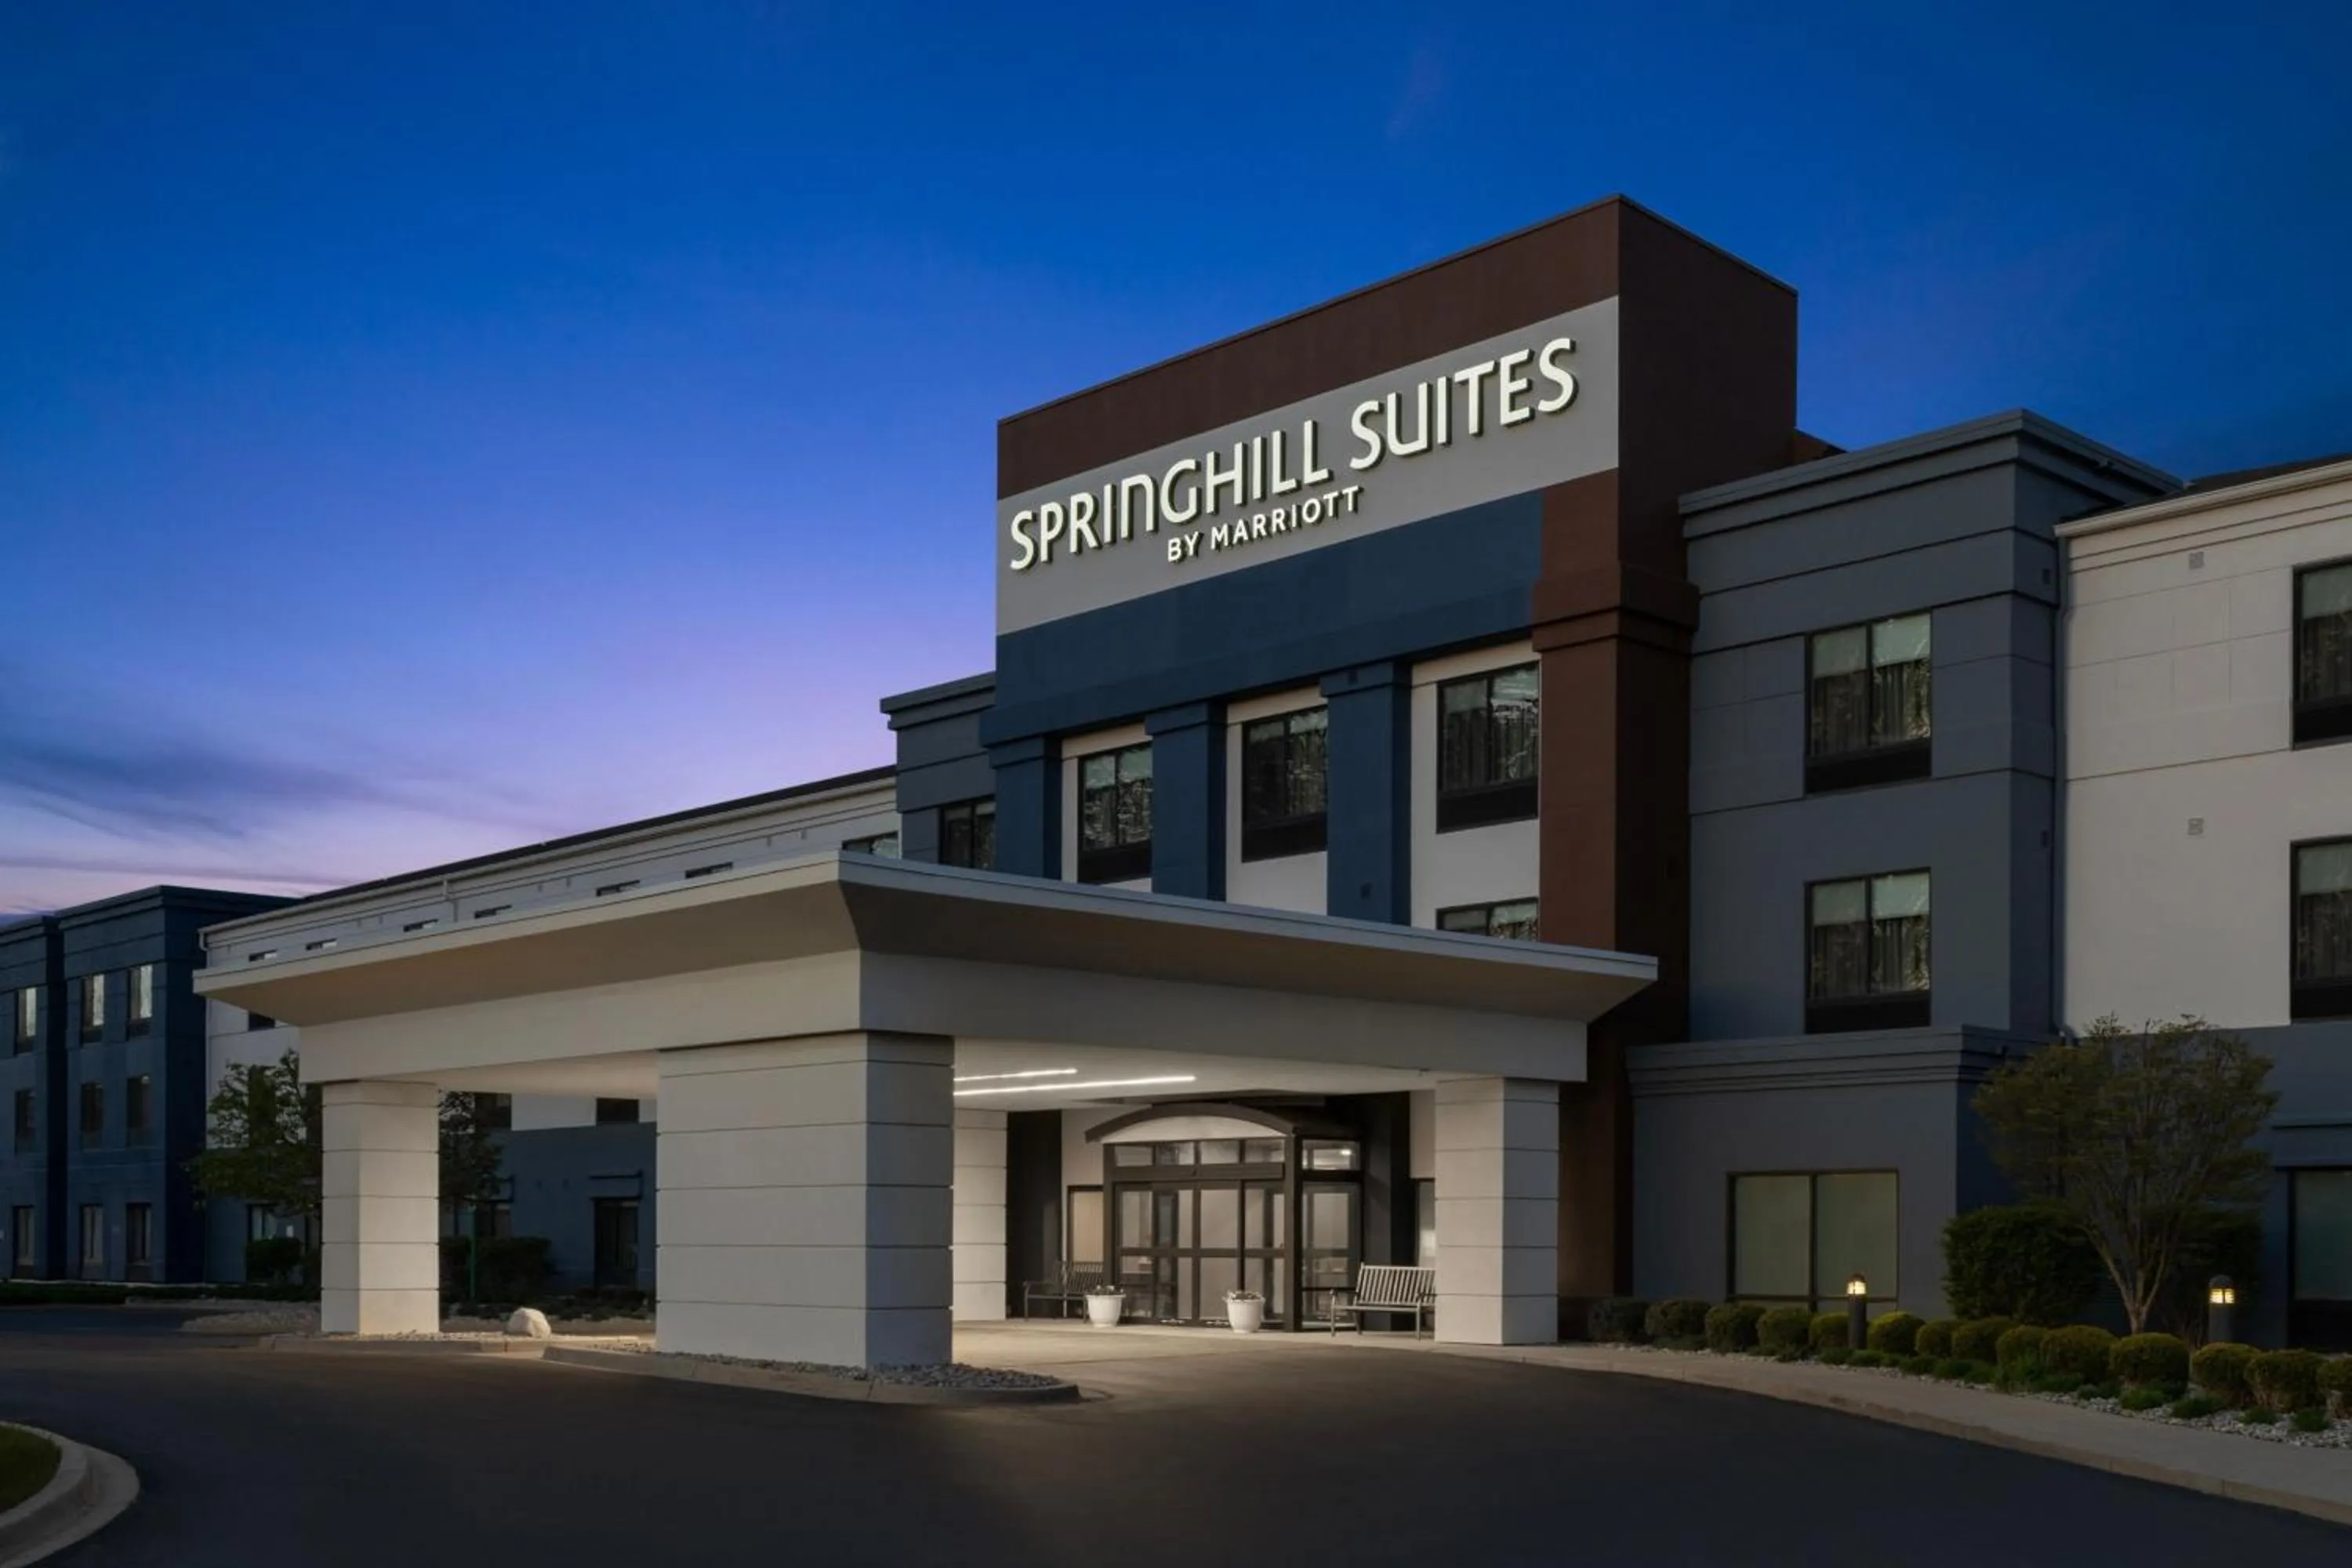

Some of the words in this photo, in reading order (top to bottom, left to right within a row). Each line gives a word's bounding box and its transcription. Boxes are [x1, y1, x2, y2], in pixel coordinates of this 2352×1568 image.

[1009, 419, 1331, 571] SPRINGHILL
[1348, 337, 1576, 470] SUITES
[1167, 531, 1200, 563] BY
[1210, 485, 1361, 550] MARRIOTT
